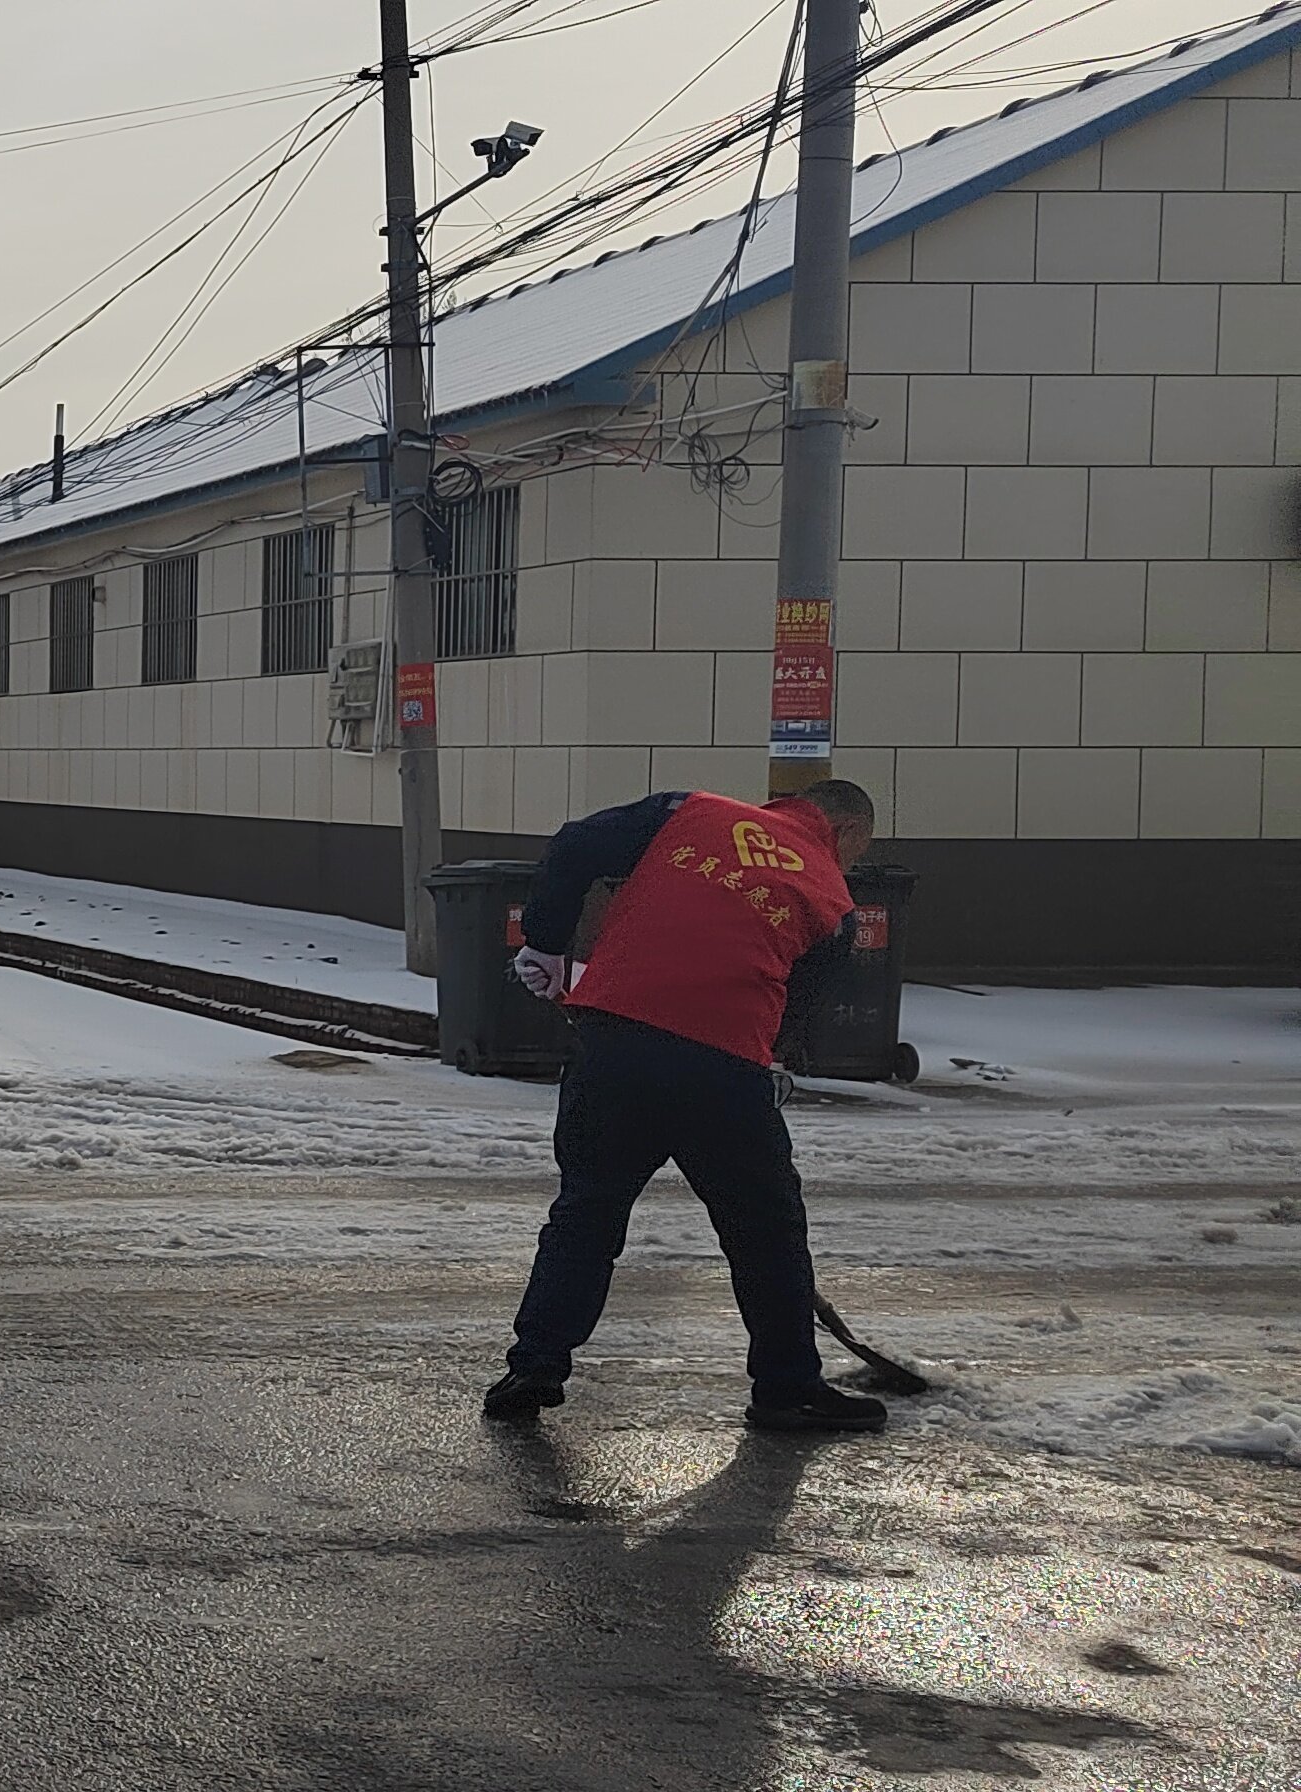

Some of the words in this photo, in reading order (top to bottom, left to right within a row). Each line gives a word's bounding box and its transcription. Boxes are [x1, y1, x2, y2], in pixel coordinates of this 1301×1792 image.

[666, 845, 792, 927] 党员志愿者
